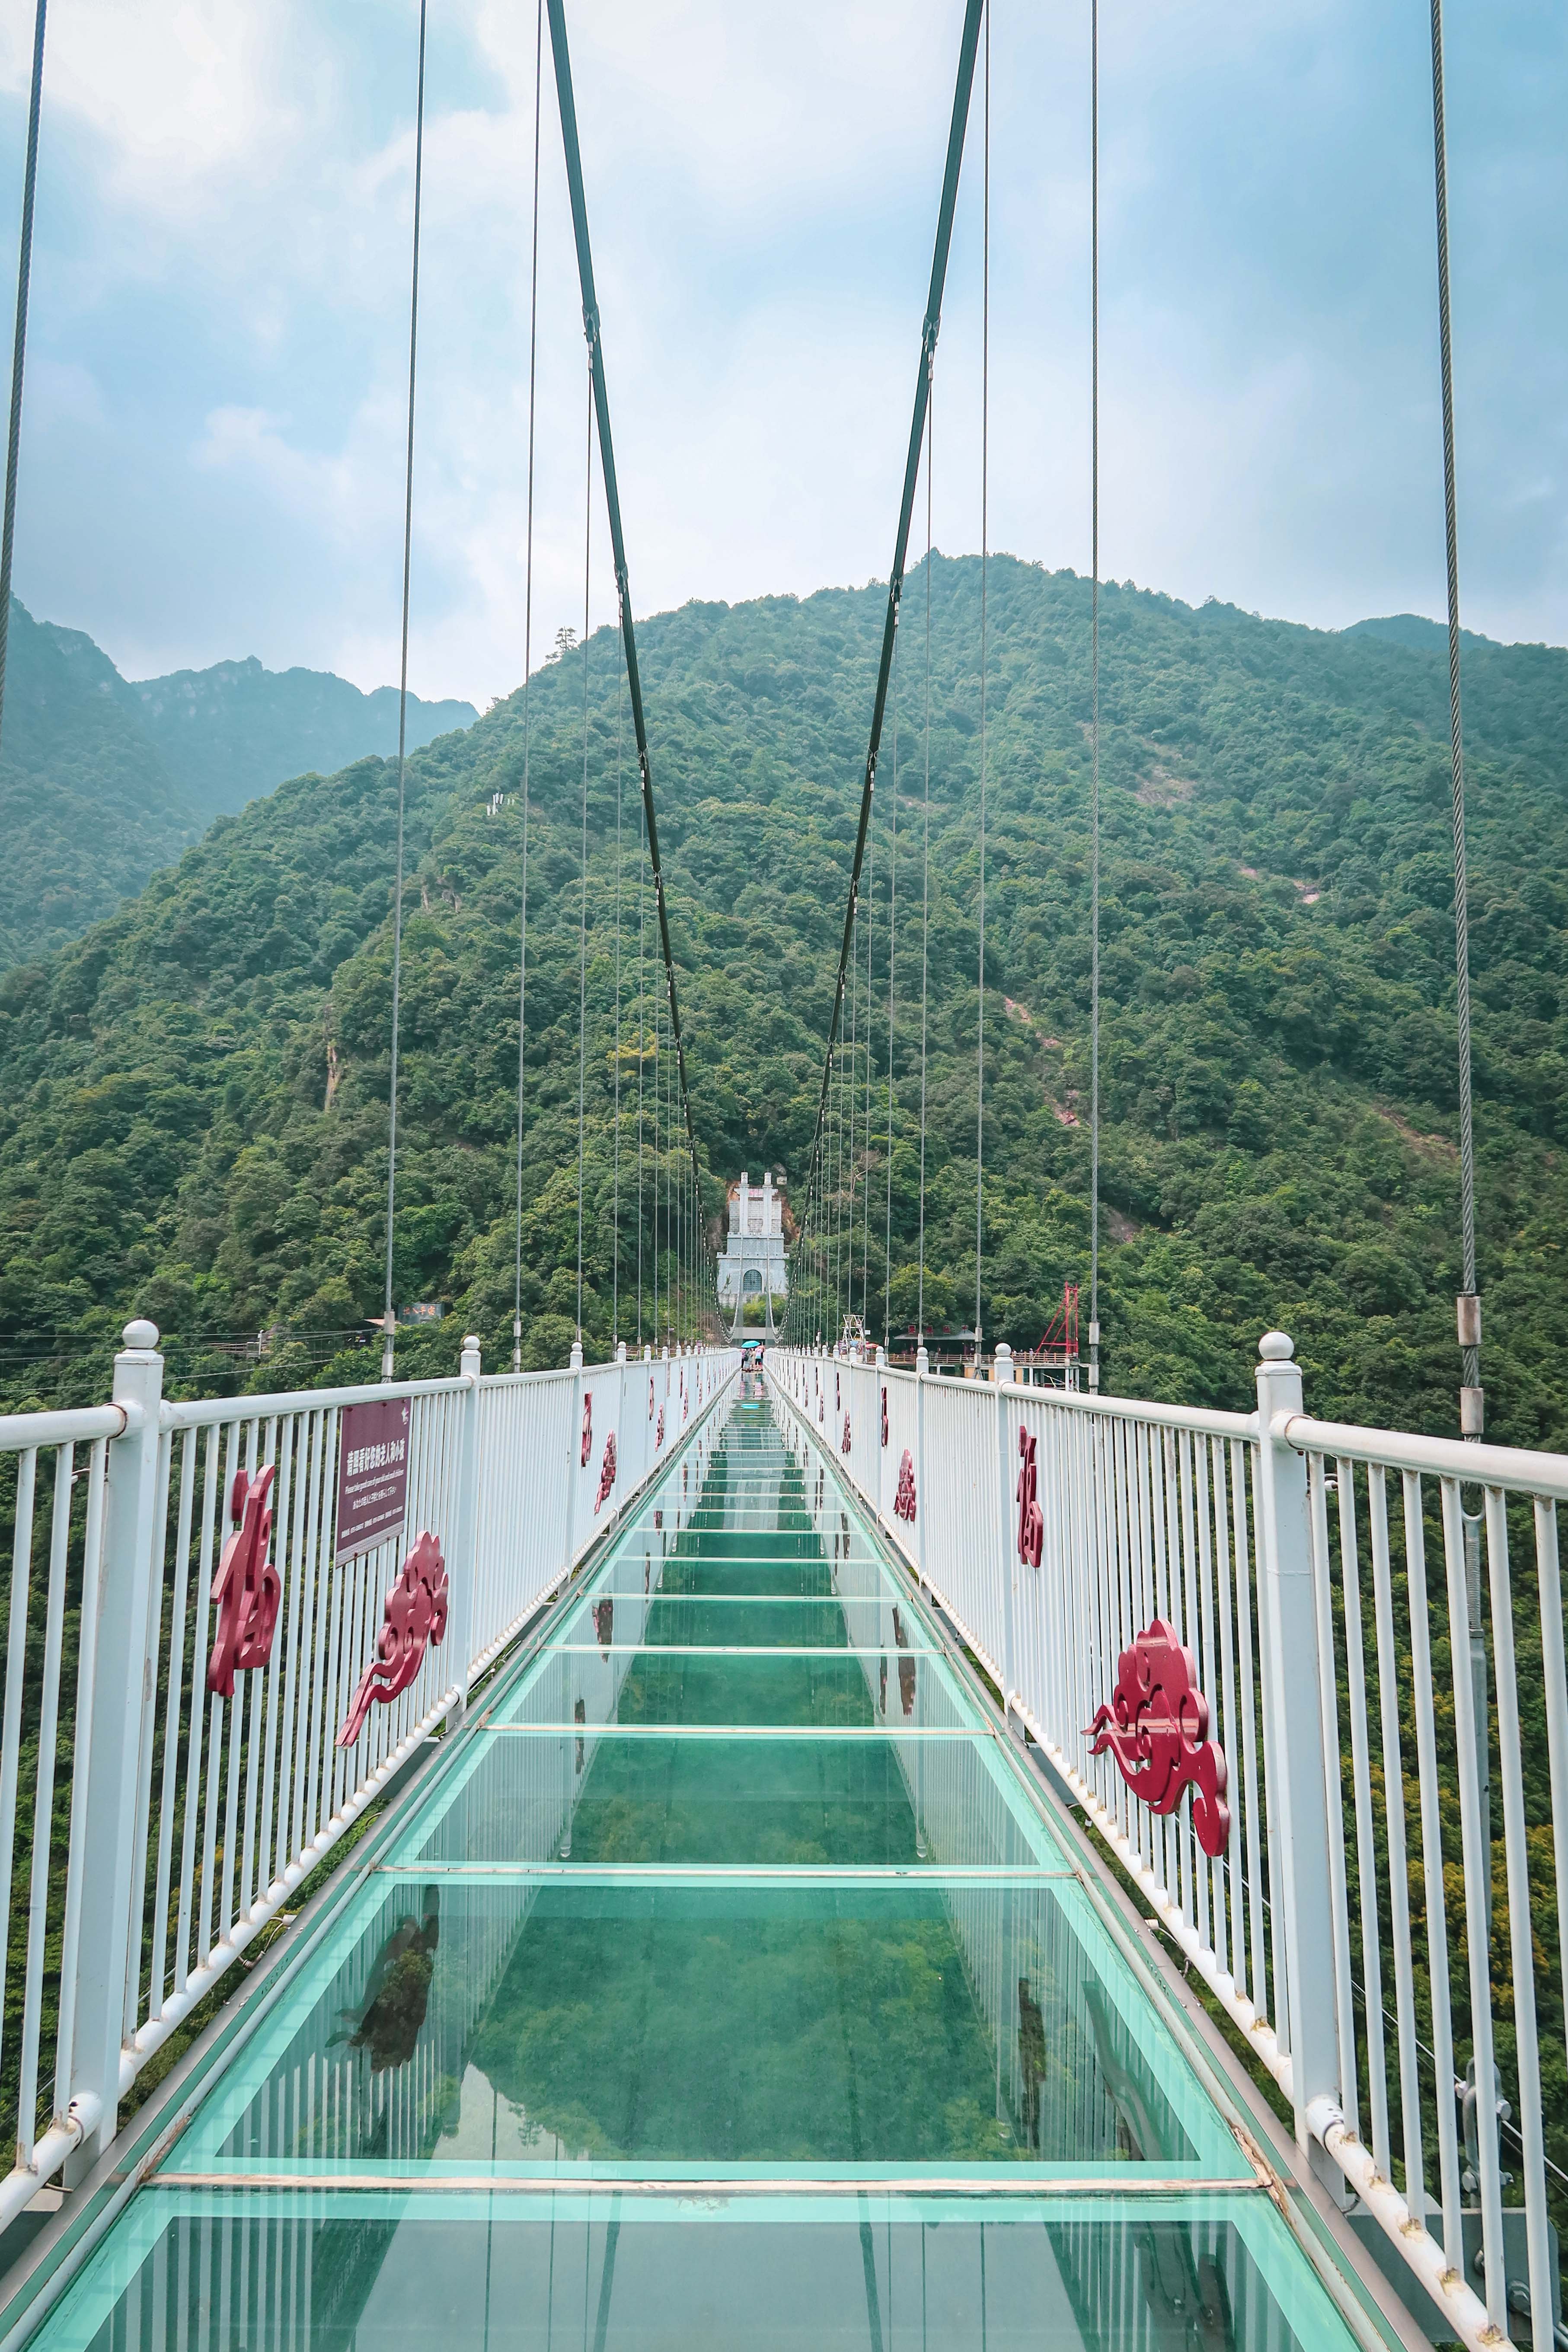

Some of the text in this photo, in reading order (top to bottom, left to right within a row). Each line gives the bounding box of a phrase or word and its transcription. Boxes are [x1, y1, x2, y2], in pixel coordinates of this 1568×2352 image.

[347, 1438, 405, 1477] 请照看好您的老人和小孩
